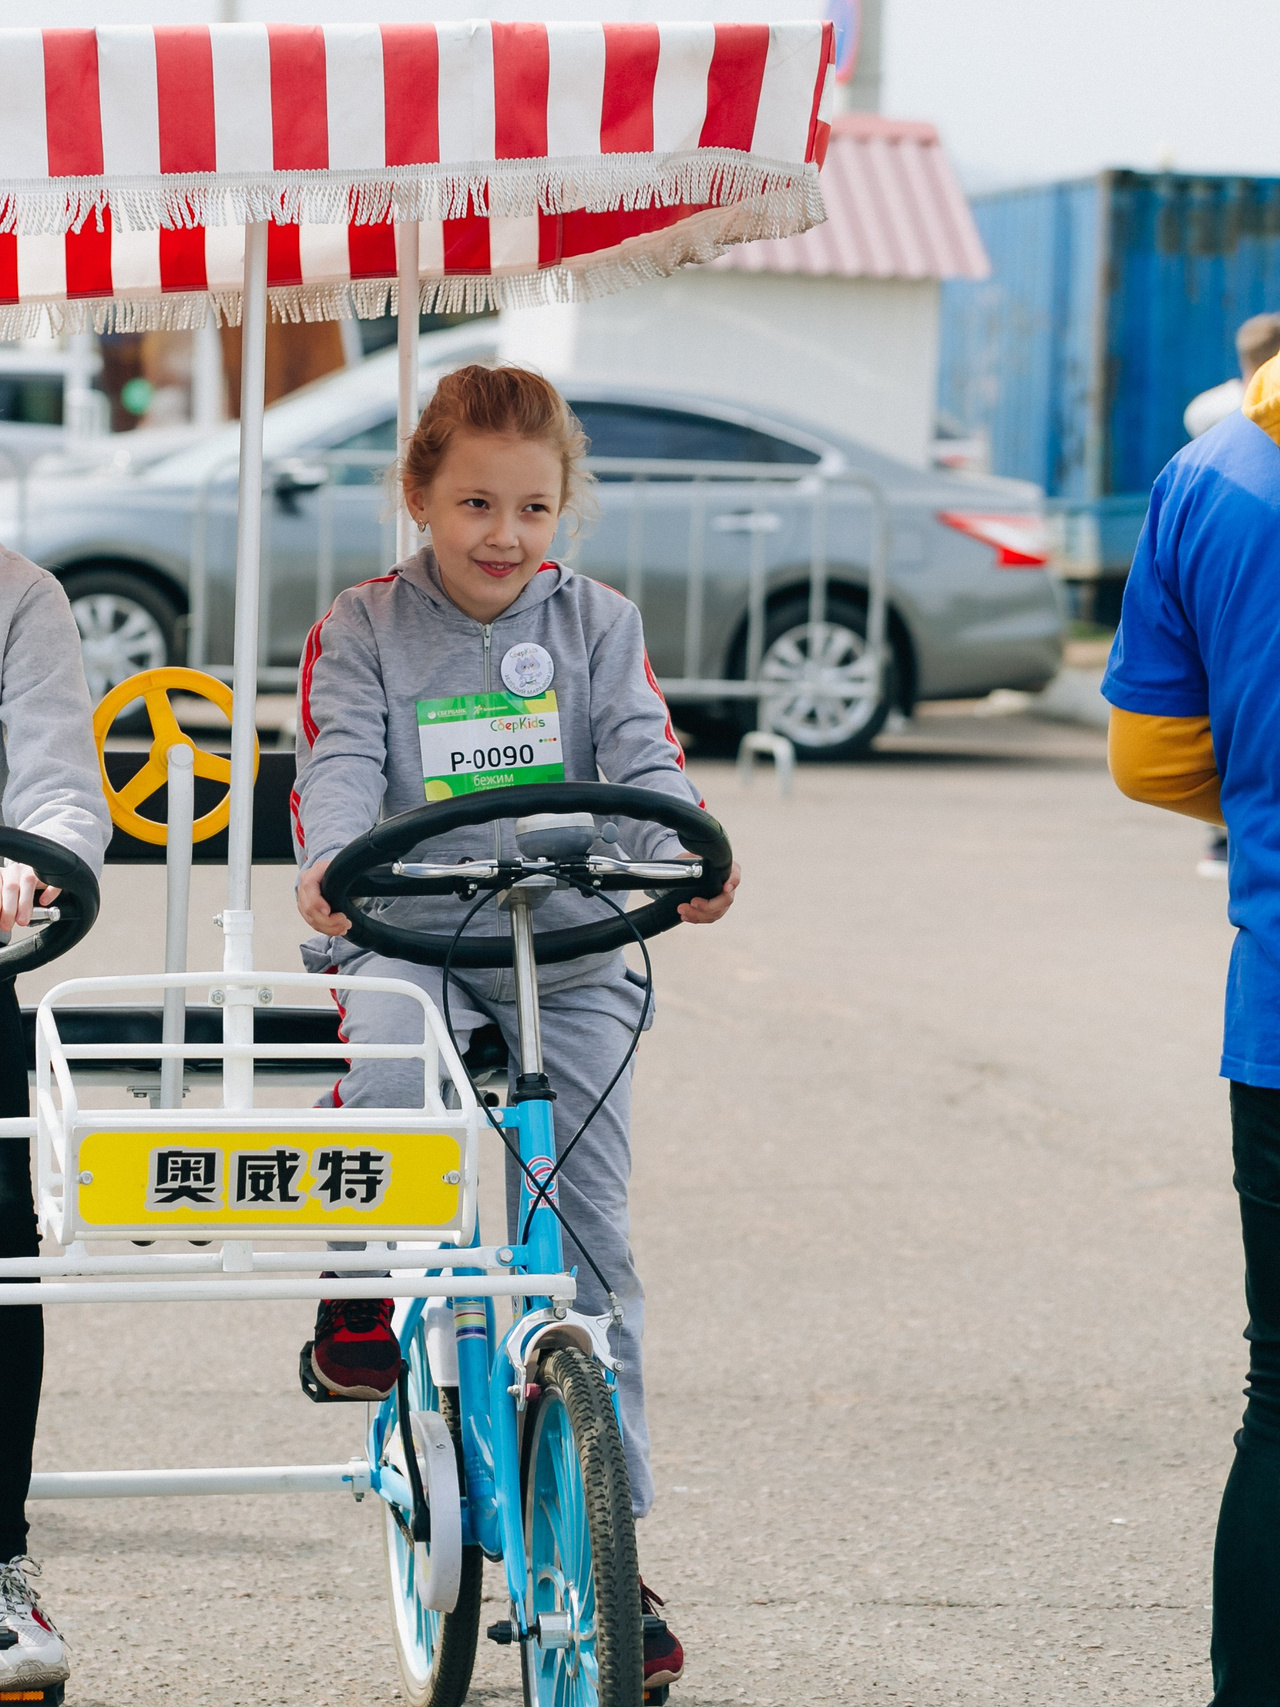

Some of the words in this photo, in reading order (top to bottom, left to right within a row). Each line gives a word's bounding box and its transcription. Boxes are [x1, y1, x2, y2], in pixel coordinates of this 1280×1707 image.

[490, 717, 545, 733] СберKids
[450, 744, 534, 772] P-0090
[473, 773, 514, 786] бежим
[154, 1150, 385, 1204] 奥威特
